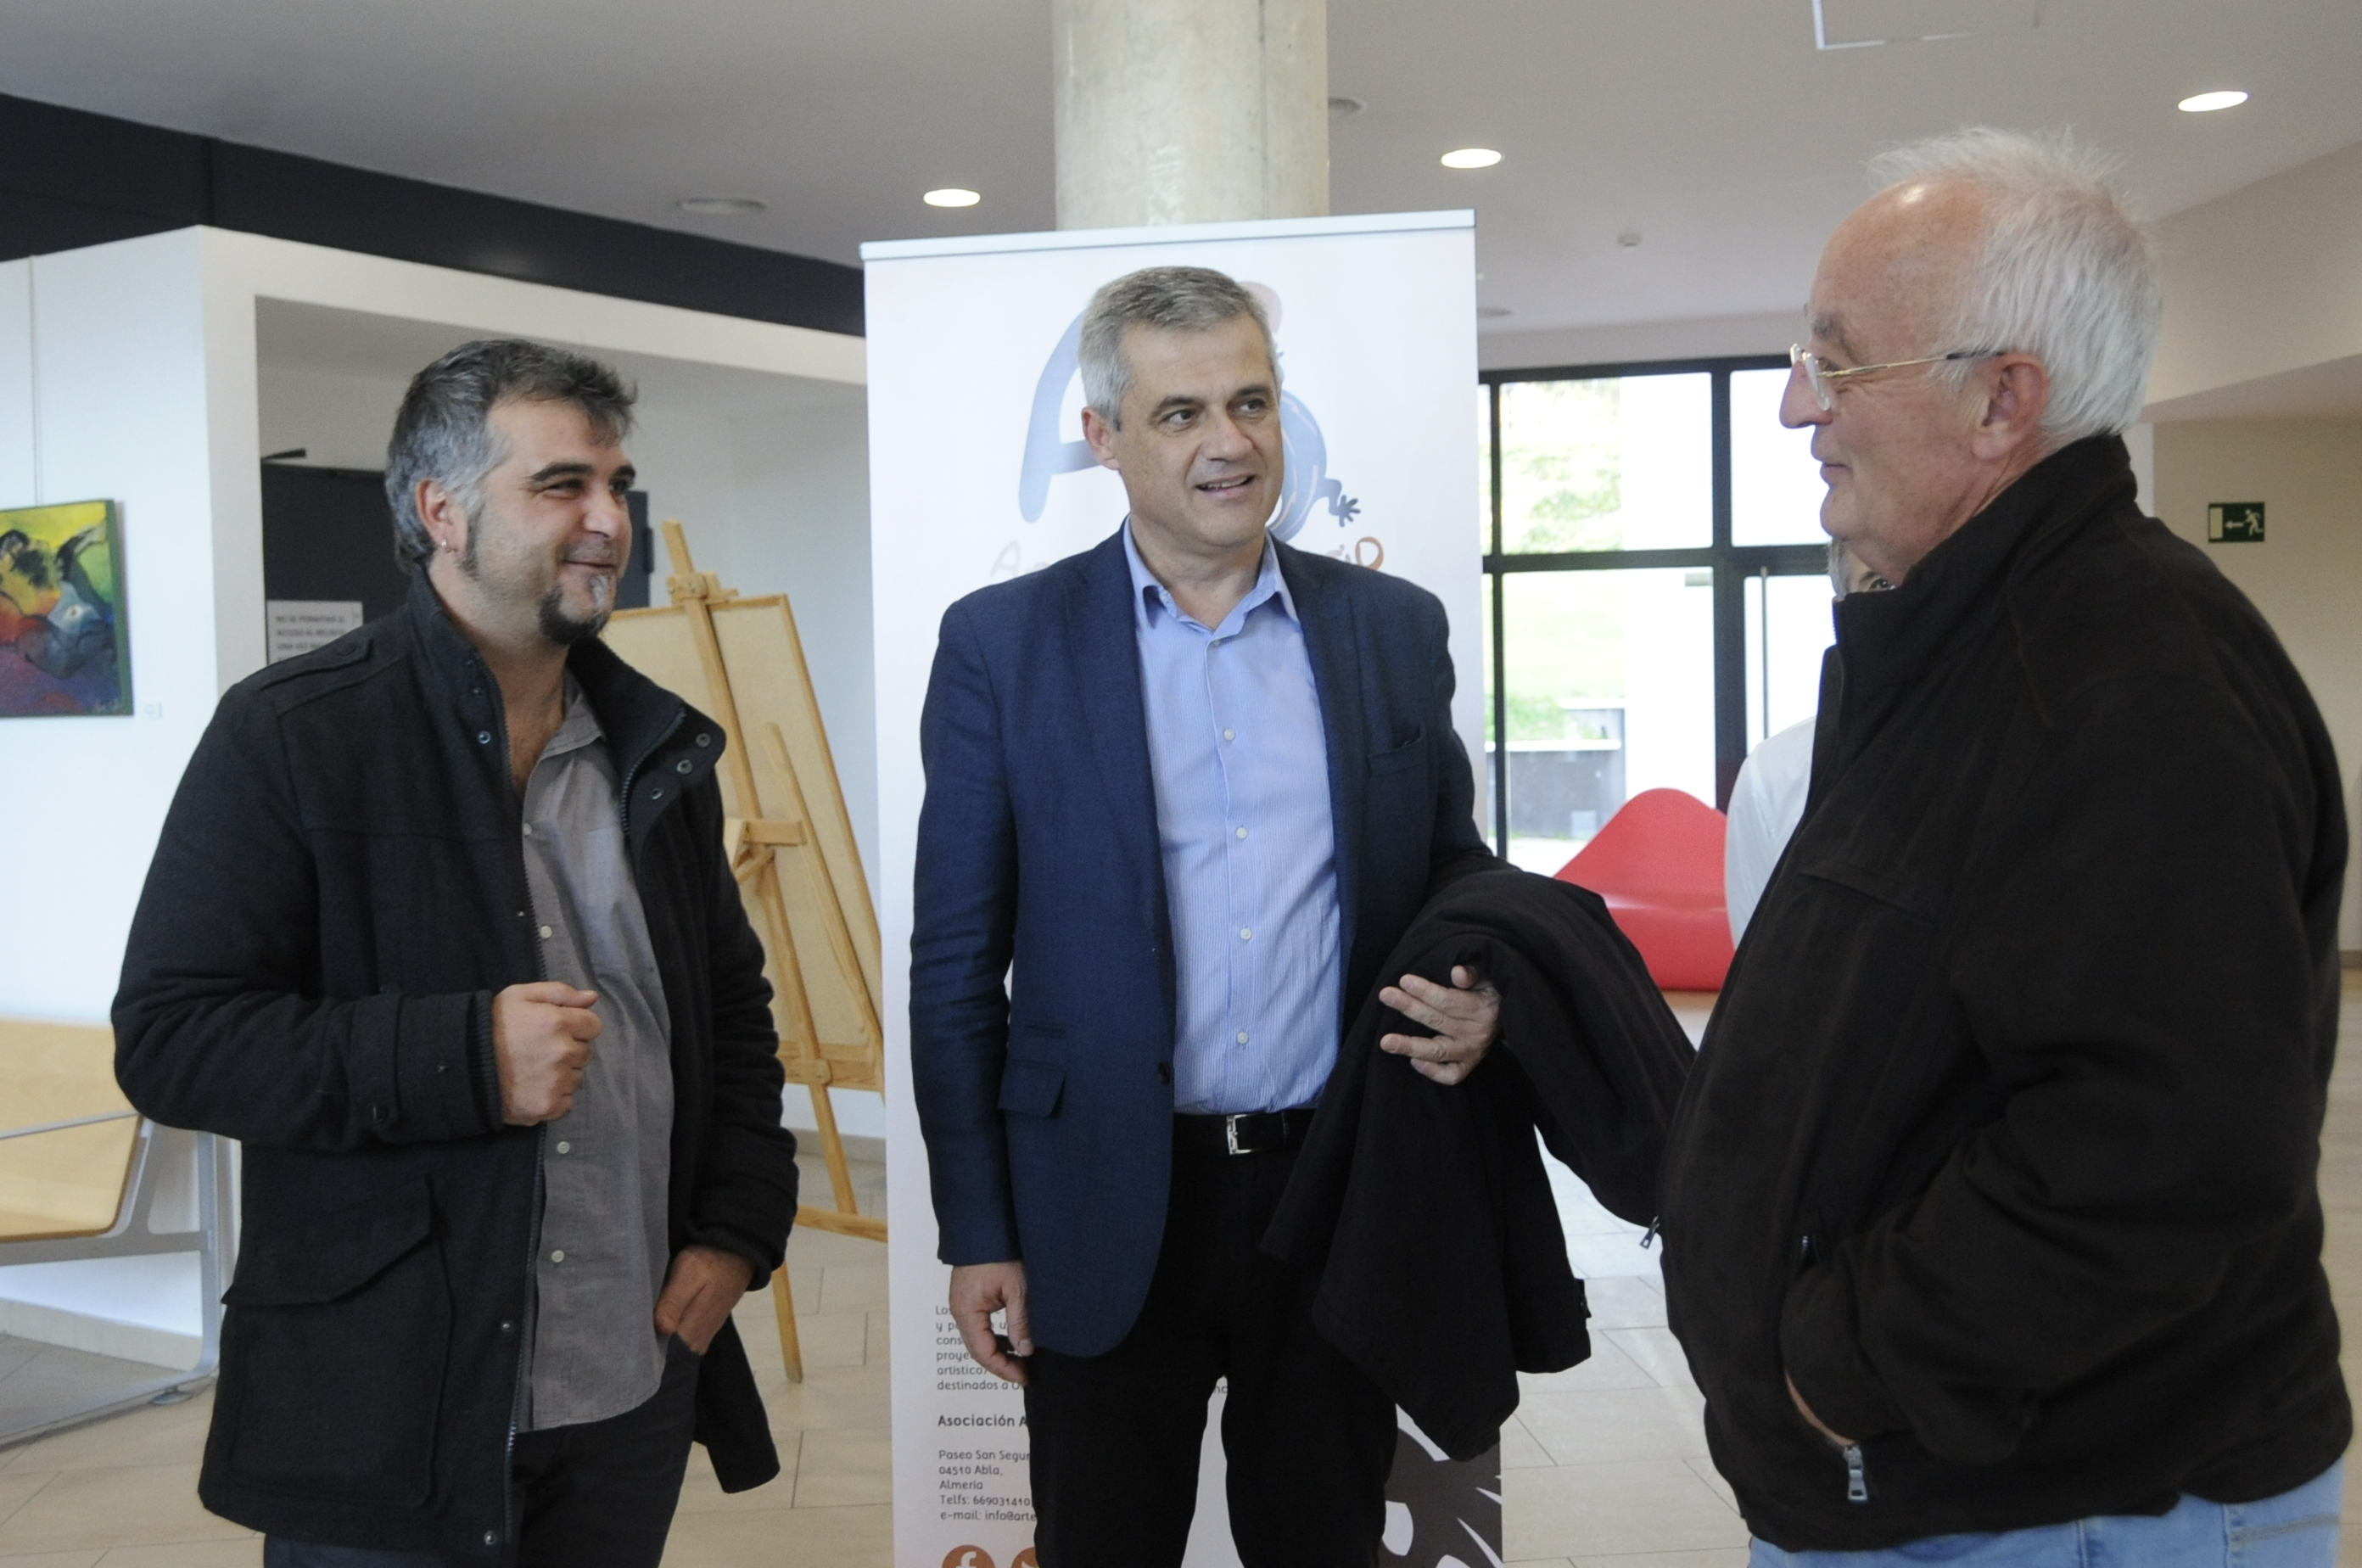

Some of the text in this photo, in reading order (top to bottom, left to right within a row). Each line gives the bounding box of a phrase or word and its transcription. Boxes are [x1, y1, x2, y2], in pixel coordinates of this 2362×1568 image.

[936, 1336, 963, 1345] cons
[936, 1352, 971, 1363] proye
[937, 1380, 999, 1390] destinados
[938, 1414, 1016, 1426] Asociación
[938, 1449, 973, 1460] Paseo
[975, 1450, 996, 1460] San
[938, 1465, 1004, 1476] 04510 Abla,
[939, 1480, 983, 1490] Almería
[940, 1494, 970, 1504] Telfs:
[940, 1509, 1037, 1521] e-mail: info@arte
